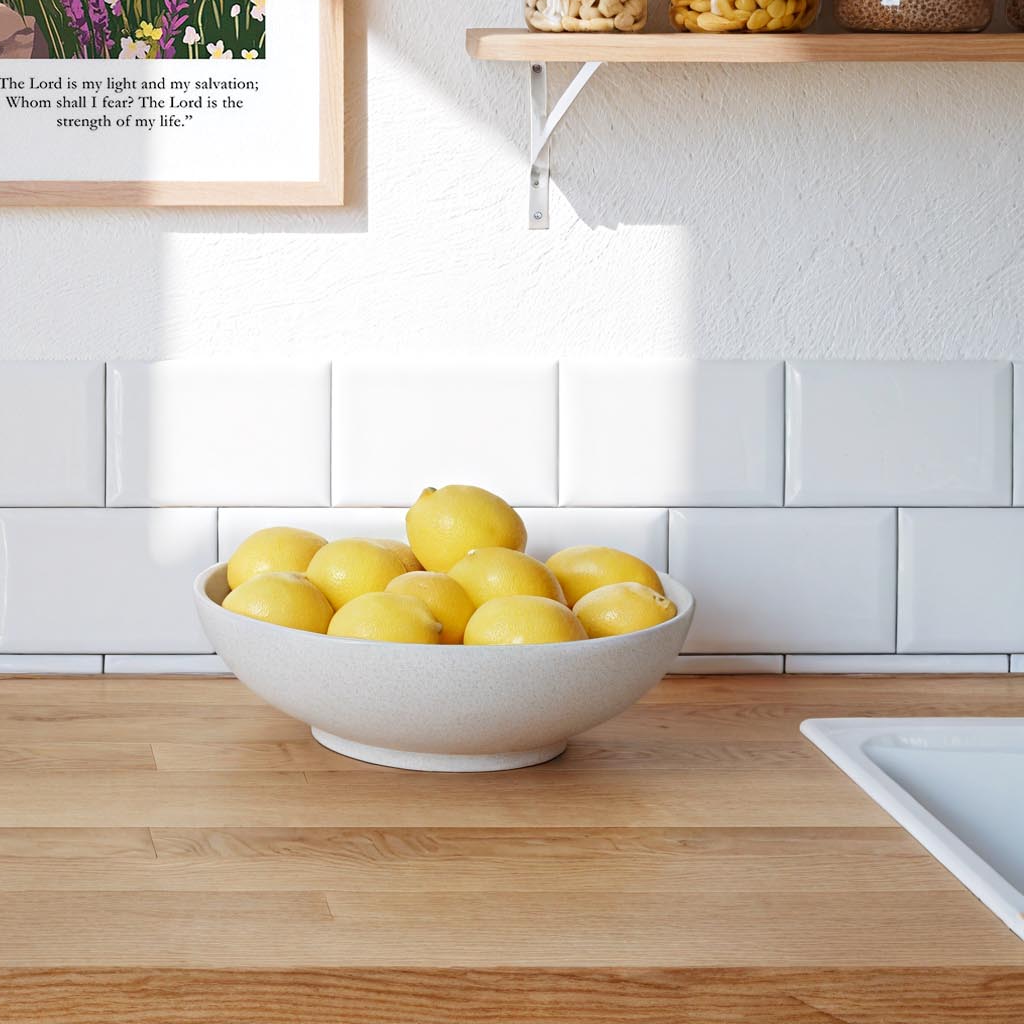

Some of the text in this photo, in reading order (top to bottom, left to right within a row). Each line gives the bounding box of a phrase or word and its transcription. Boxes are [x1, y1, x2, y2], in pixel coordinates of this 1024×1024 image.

[29, 76, 63, 90] Lord
[66, 76, 78, 90] is
[81, 80, 103, 94] my
[106, 76, 138, 94] light
[140, 76, 166, 90] and
[170, 80, 192, 94] my
[194, 76, 259, 93] salvation;
[5, 96, 244, 108] Whom shall I fear? The Lord is the
[56, 115, 193, 131] strength of my life.”
